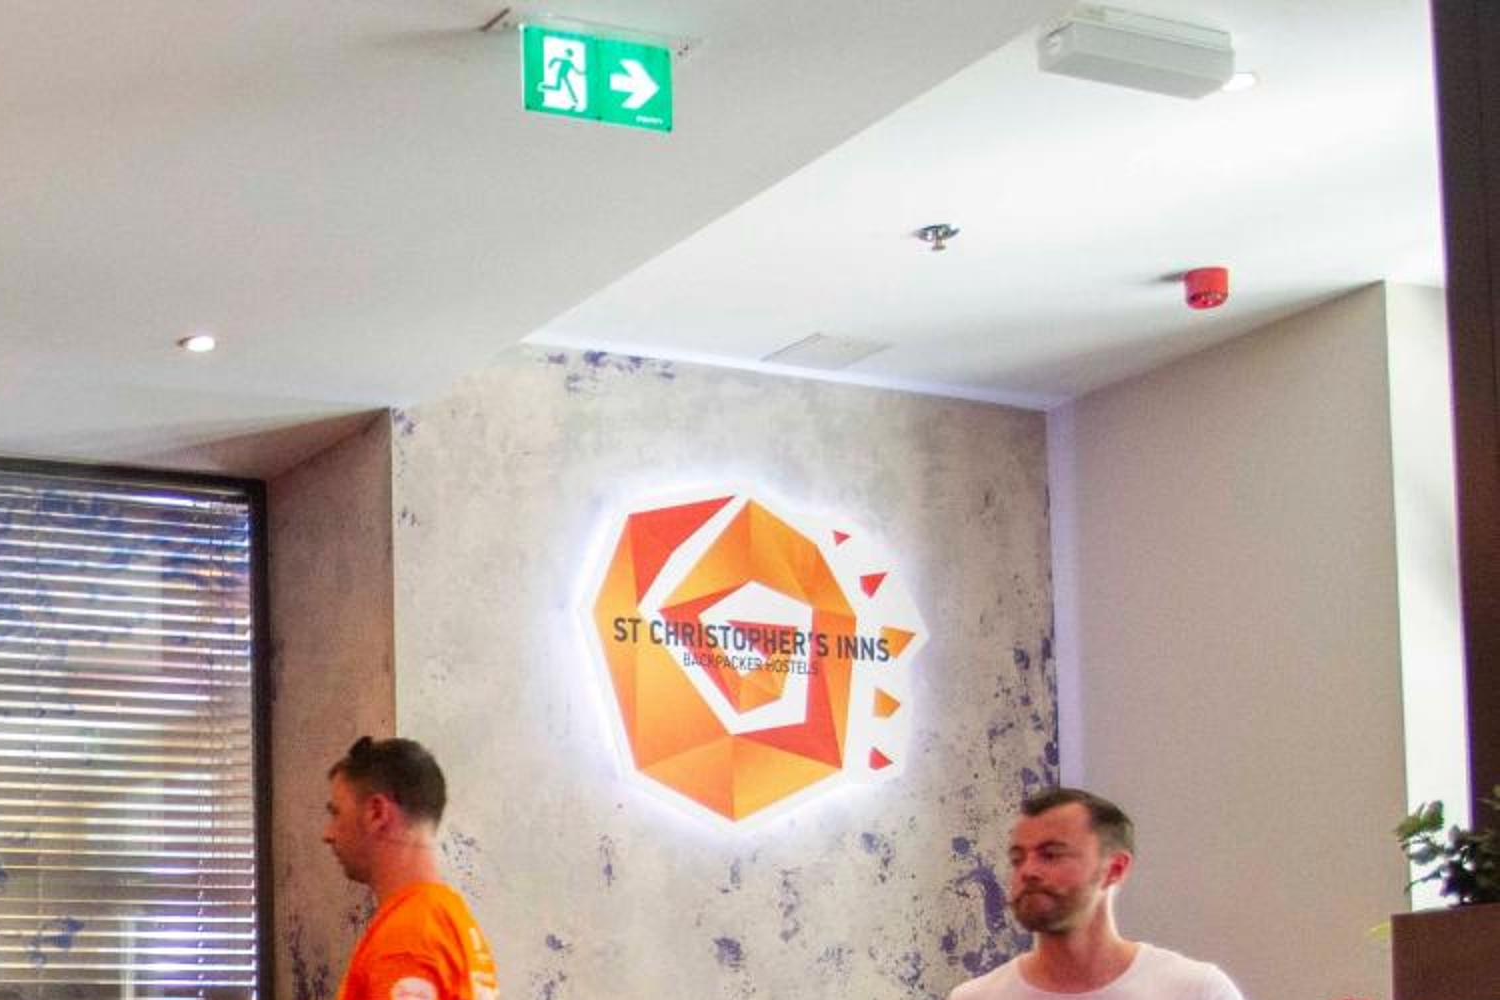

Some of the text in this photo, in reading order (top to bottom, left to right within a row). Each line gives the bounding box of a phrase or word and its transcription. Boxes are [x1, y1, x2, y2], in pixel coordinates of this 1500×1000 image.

[613, 617, 890, 662] ST CHRISTOPHER'S INNS
[683, 652, 819, 676] BACKPACKER HOSTELS
